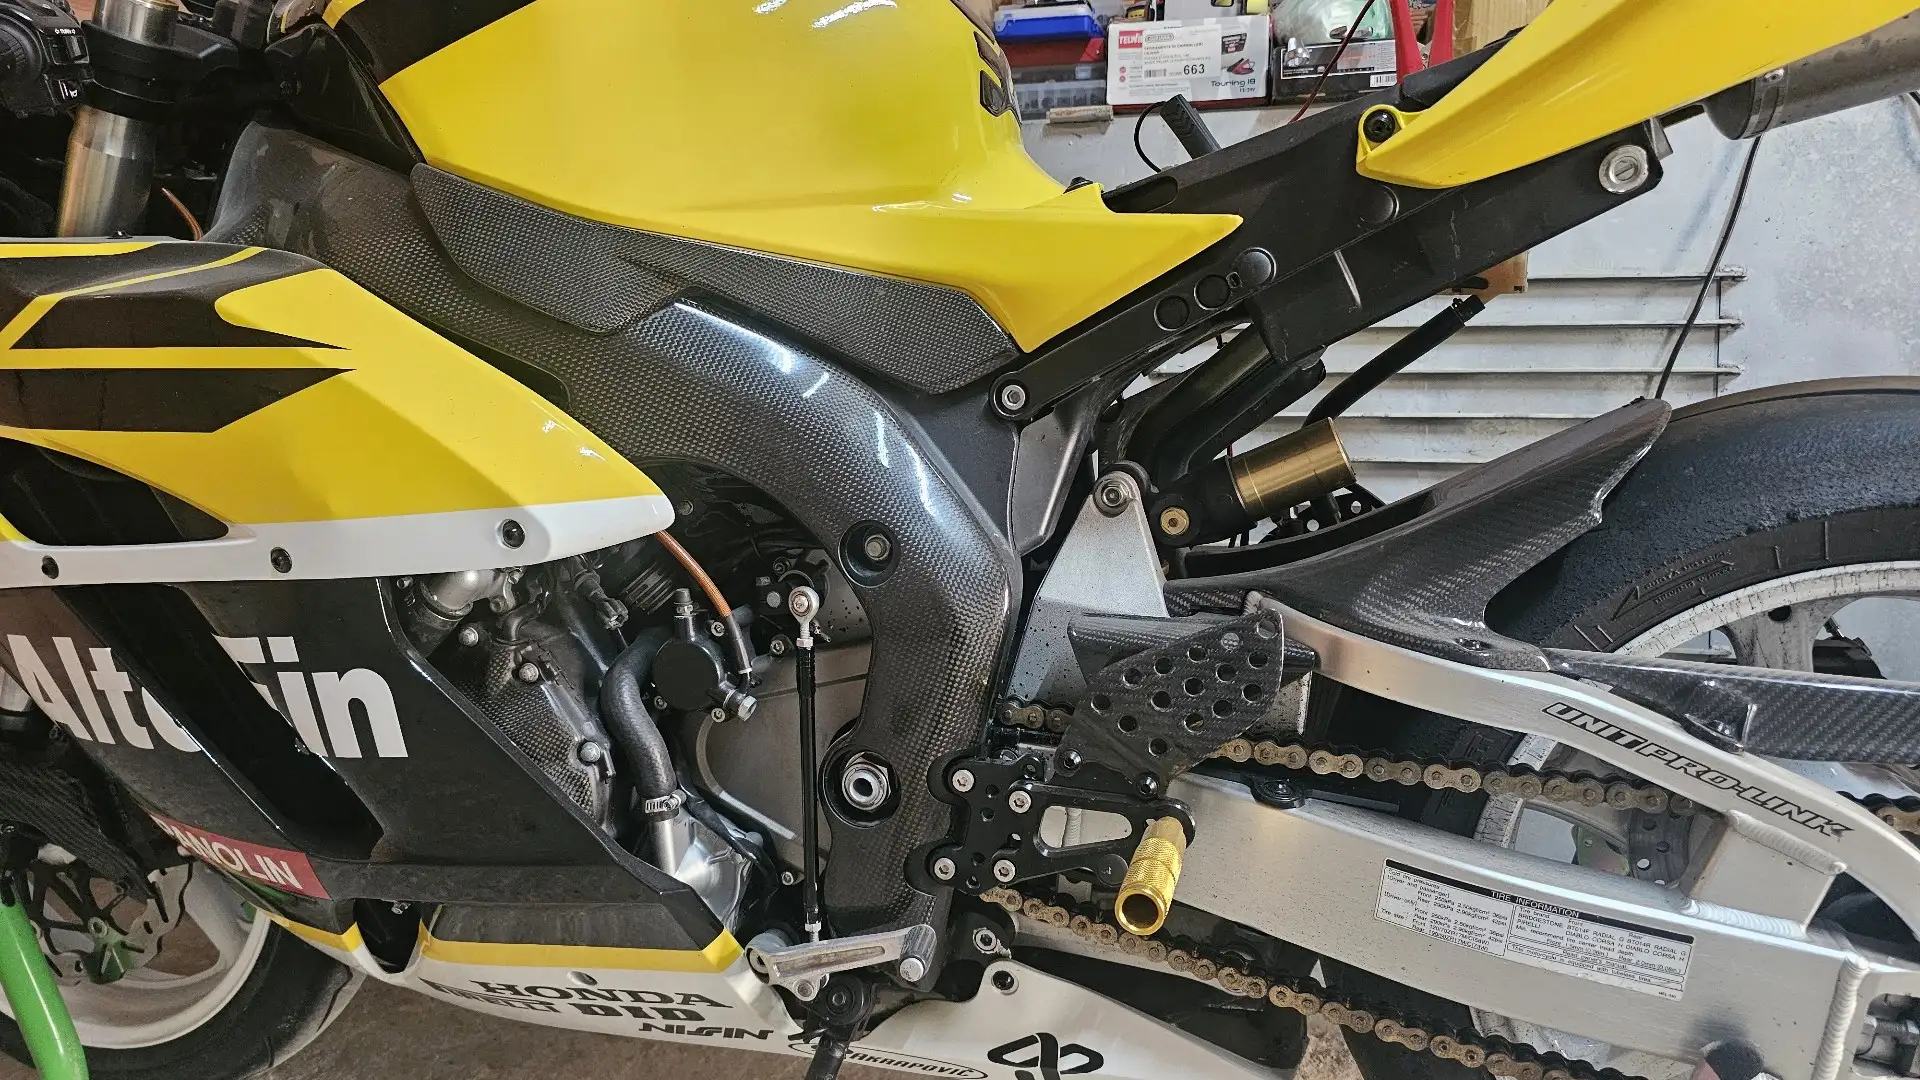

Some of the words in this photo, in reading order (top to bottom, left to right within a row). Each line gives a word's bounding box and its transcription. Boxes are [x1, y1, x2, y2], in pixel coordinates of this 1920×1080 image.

[1183, 64, 1206, 76] 663
[1211, 80, 1246, 88] Touring
[1541, 702, 1649, 750] UNIT
[1636, 742, 1855, 837] PRO-LINK
[150, 814, 303, 890] PANOLIN
[1490, 890, 1511, 901] TIRE
[1515, 896, 1579, 918] INFORMATION
[1516, 918, 1540, 929] PIRELLI
[1565, 930, 1589, 940] DIABLO
[1591, 936, 1614, 946] CORSA
[1625, 944, 1649, 954] DIABLO
[1652, 951, 1676, 959] CORSA
[1517, 912, 1563, 928] BRIDGESTONE
[1566, 924, 1589, 934] BT014F
[1592, 930, 1616, 940] RADIAL
[1626, 939, 1651, 948] BT014R
[1653, 945, 1677, 953] RADIAL
[469, 980, 735, 1008] HONDA
[567, 1002, 706, 1022] DID
[638, 1022, 774, 1040] NISSIN
